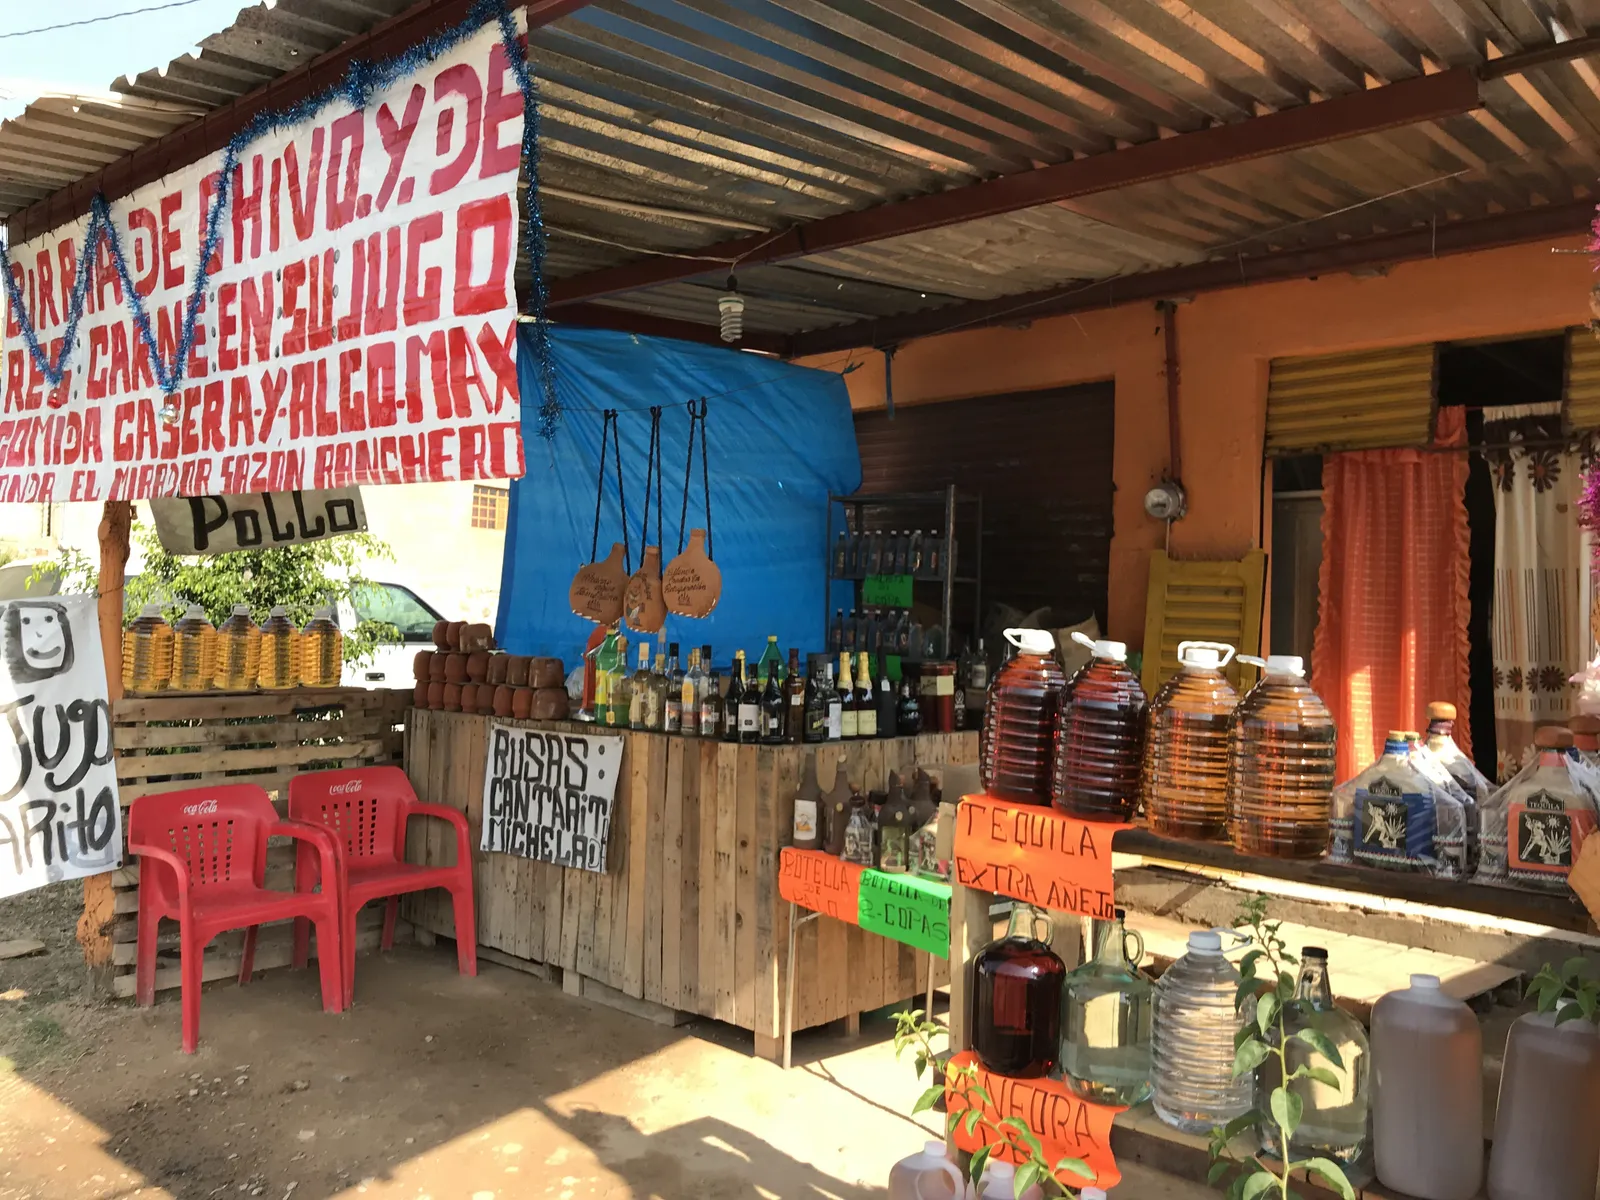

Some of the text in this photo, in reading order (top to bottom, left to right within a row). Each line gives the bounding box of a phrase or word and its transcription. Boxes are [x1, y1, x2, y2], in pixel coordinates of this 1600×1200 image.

[129, 191, 184, 297] DE
[218, 271, 273, 371] EN
[337, 193, 512, 342] JUGO
[70, 470, 99, 502] EL
[108, 458, 212, 502] MIRADOR
[314, 421, 525, 488] RANCHERO
[961, 803, 1098, 859] TEQUILA
[782, 851, 850, 893] BOTELLA
[803, 883, 821, 895] DE
[861, 871, 922, 901] BOTELLA
[956, 856, 1114, 919] EXTRA AÑEJO
